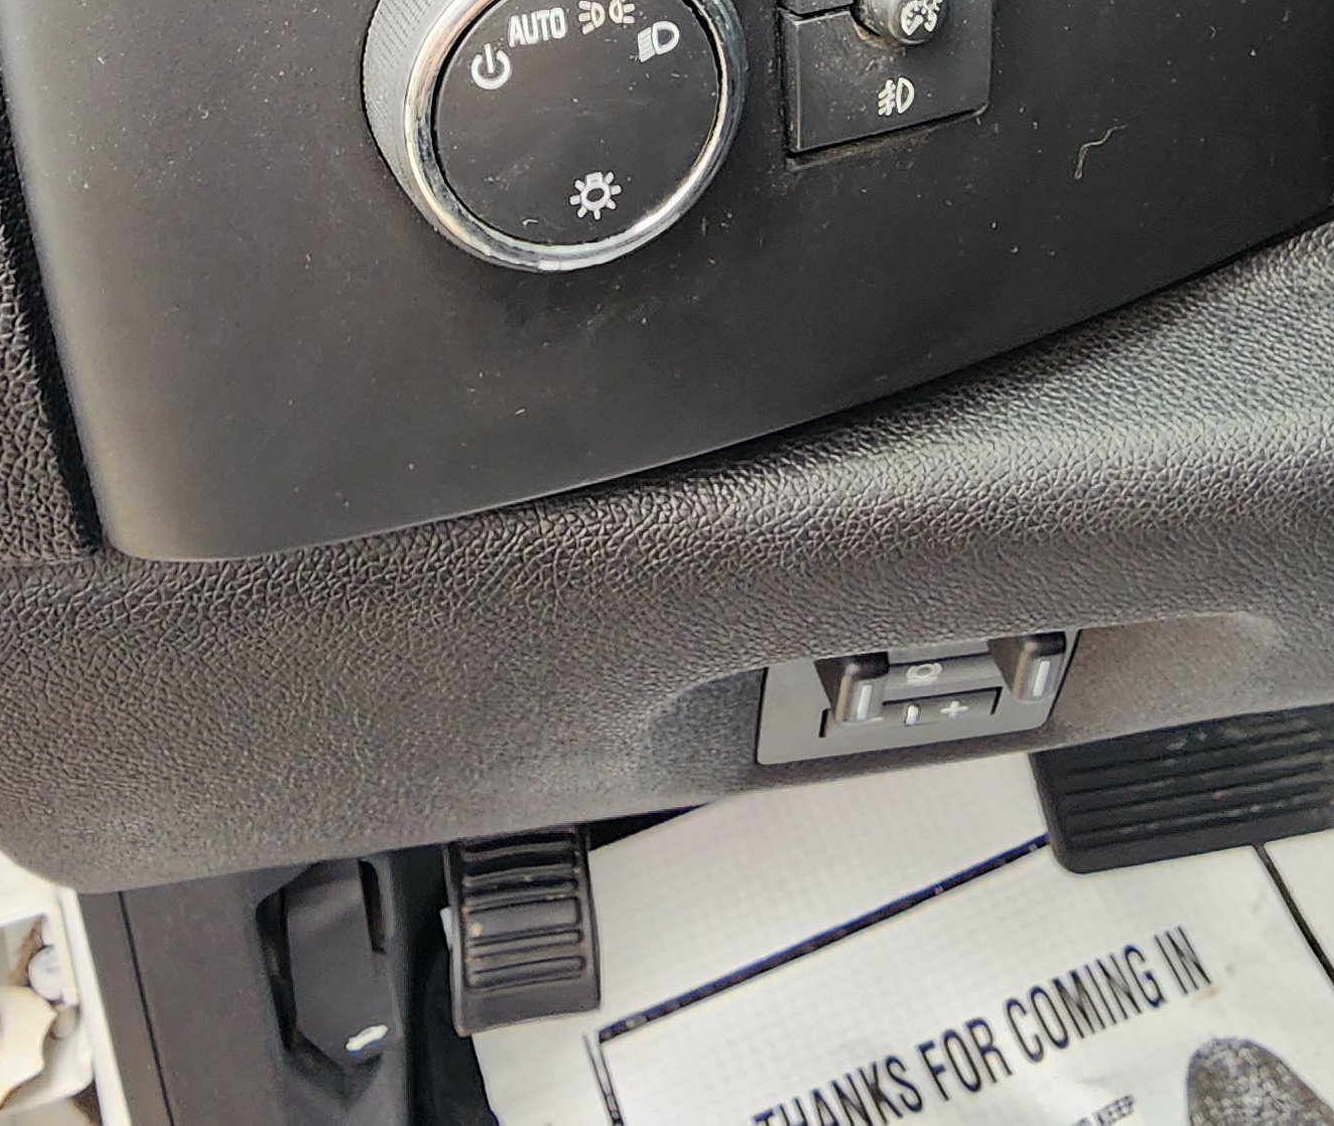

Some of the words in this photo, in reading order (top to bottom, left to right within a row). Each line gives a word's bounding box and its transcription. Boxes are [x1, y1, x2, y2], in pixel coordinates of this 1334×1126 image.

[507, 6, 567, 48] AUTO
[751, 1054, 924, 1126] HANKS
[916, 1017, 1015, 1103] FOR
[1004, 943, 1168, 1064] COMING
[1152, 924, 1214, 996] IN
